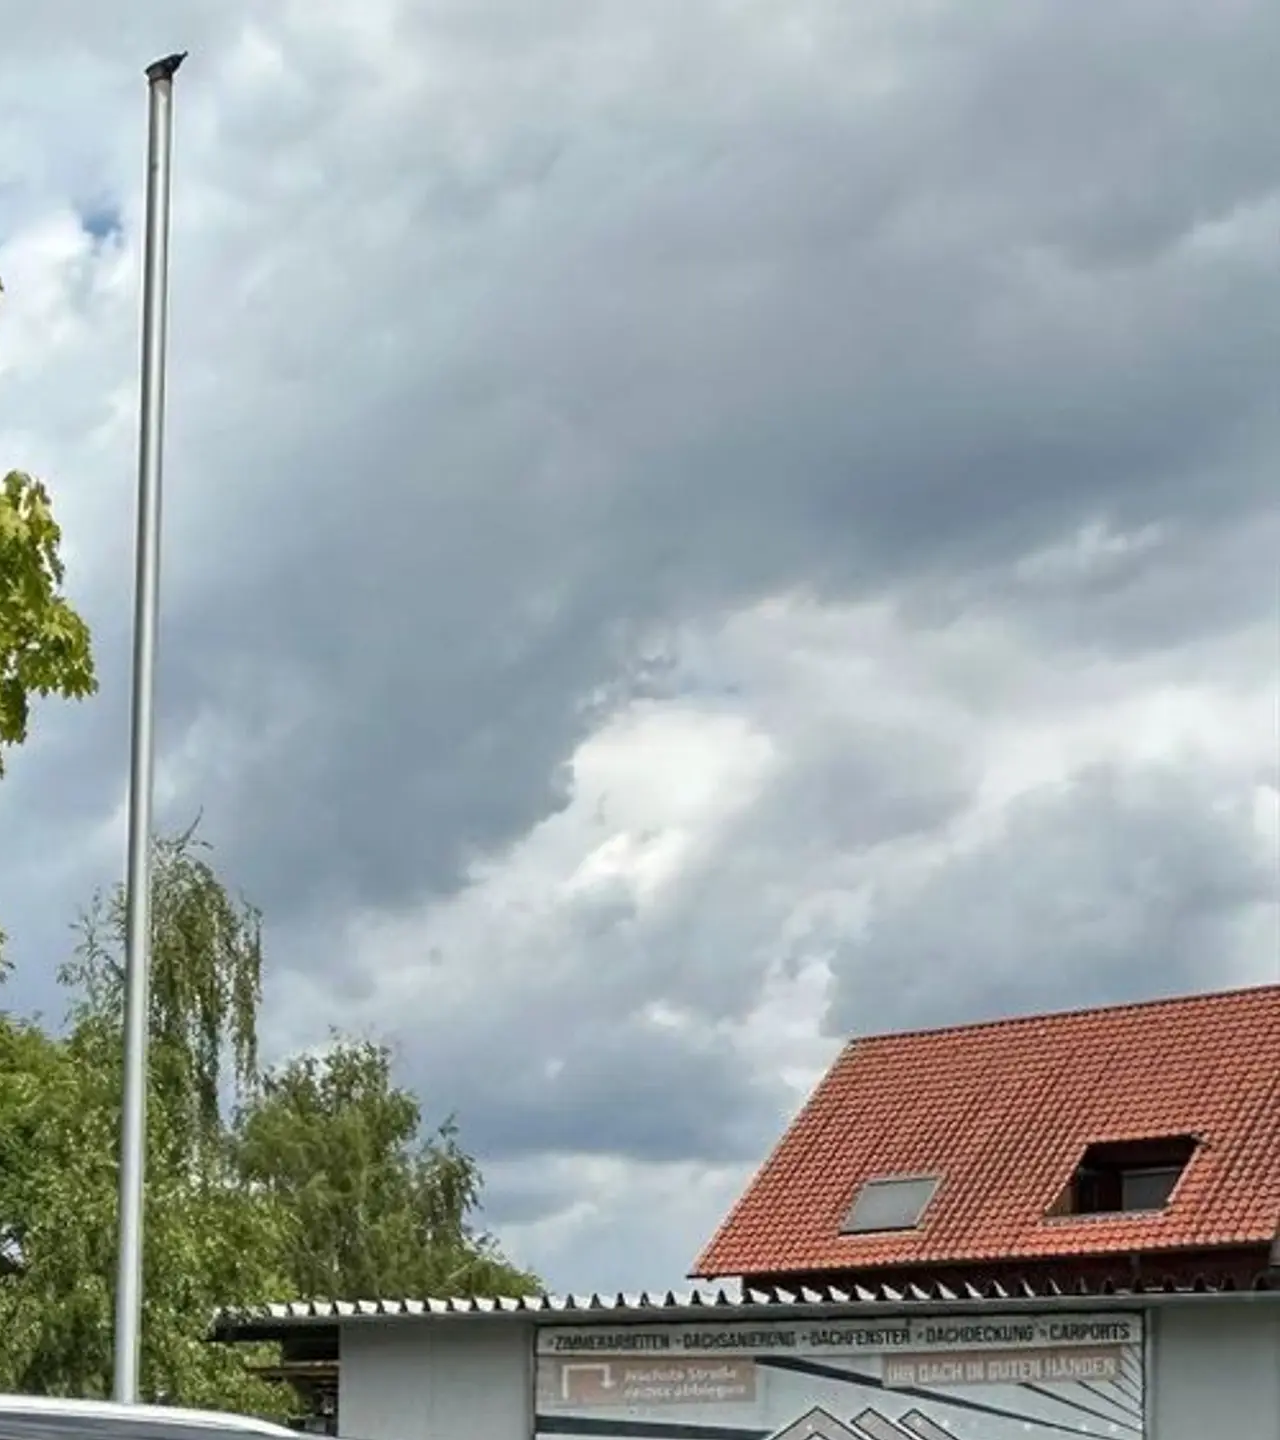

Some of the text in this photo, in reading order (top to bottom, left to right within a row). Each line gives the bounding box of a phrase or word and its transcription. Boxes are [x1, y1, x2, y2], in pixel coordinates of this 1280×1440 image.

[682, 1331, 796, 1349] DACHSANIERUNG
[810, 1328, 910, 1346] DACHFENSTER
[925, 1324, 1034, 1343] DACHDECKUNG
[1049, 1322, 1130, 1341] CARPORTS
[918, 1361, 963, 1382] DACH
[966, 1360, 985, 1380] IN
[988, 1358, 1040, 1380] GUTEN
